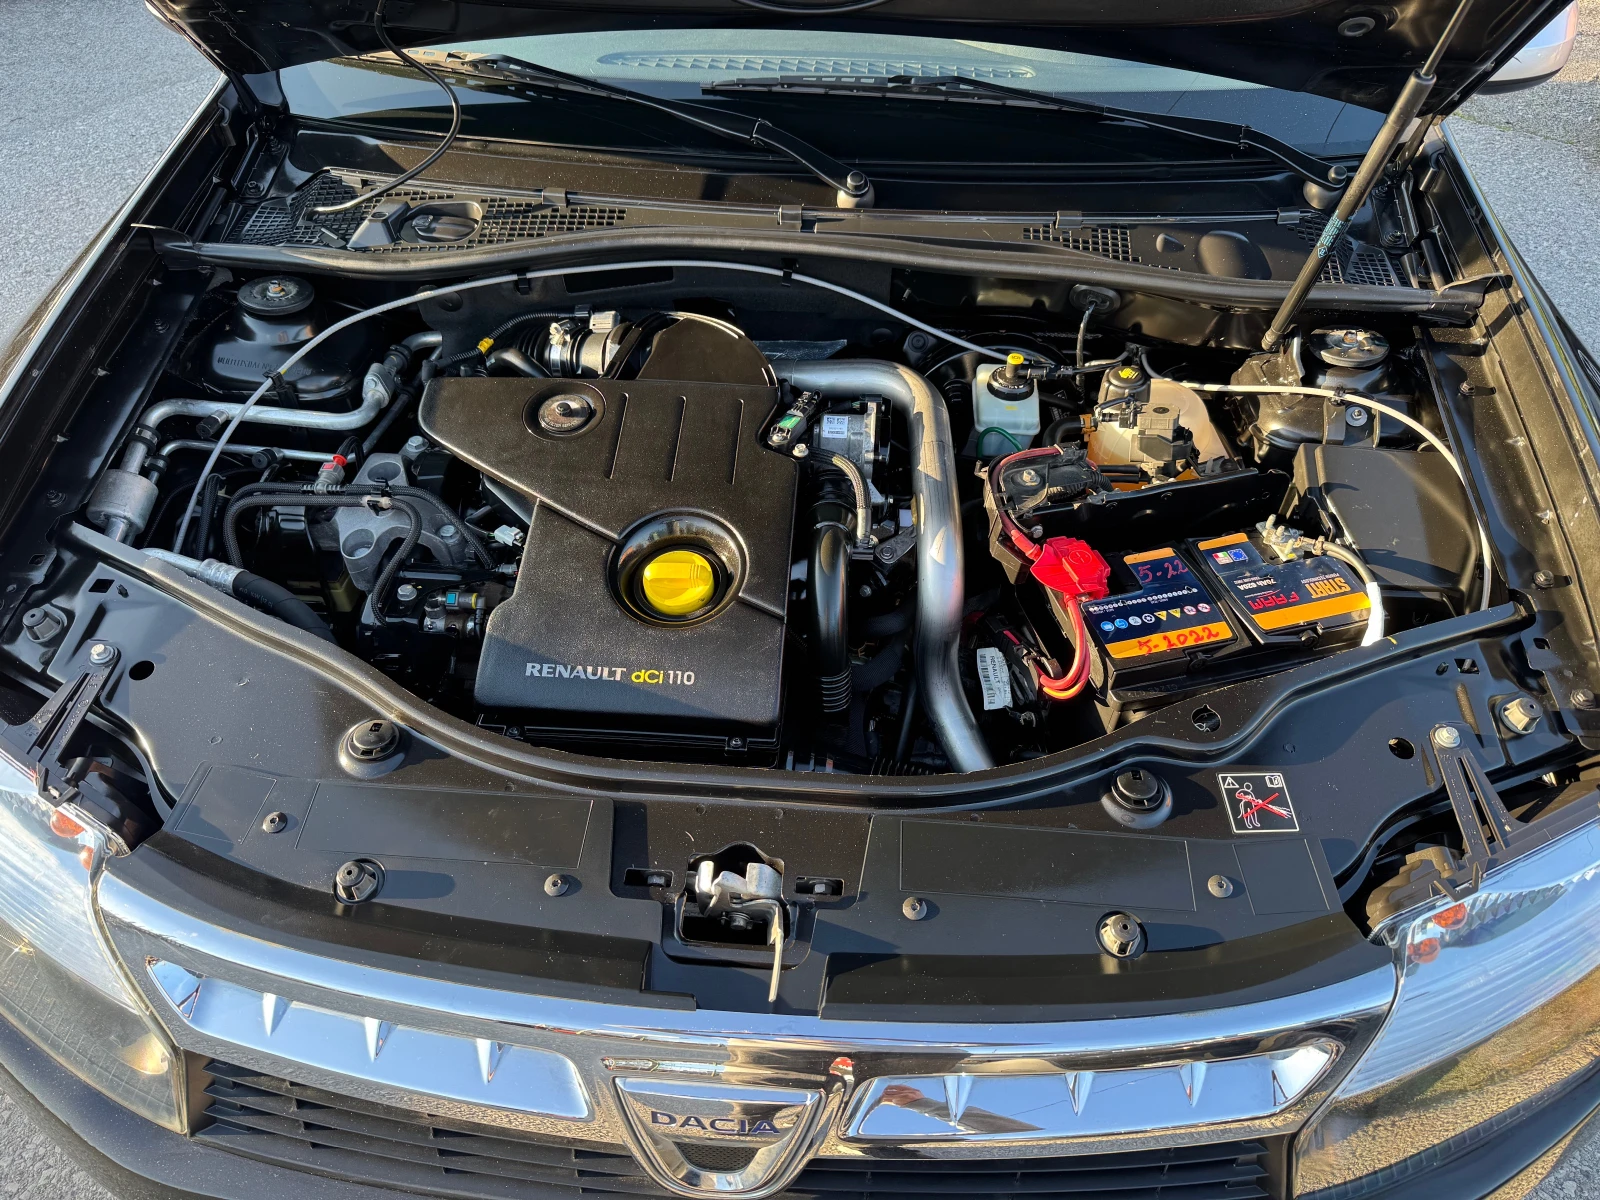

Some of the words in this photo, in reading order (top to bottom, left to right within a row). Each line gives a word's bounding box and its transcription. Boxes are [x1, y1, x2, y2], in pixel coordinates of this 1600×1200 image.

[1305, 578, 1351, 598] START
[1247, 591, 1300, 610] FAAM
[525, 662, 627, 681] RENAULT
[631, 669, 664, 684] dCi
[667, 670, 695, 686] 110
[990, 655, 1001, 684] RENAULT
[650, 1110, 781, 1135] DACIA
